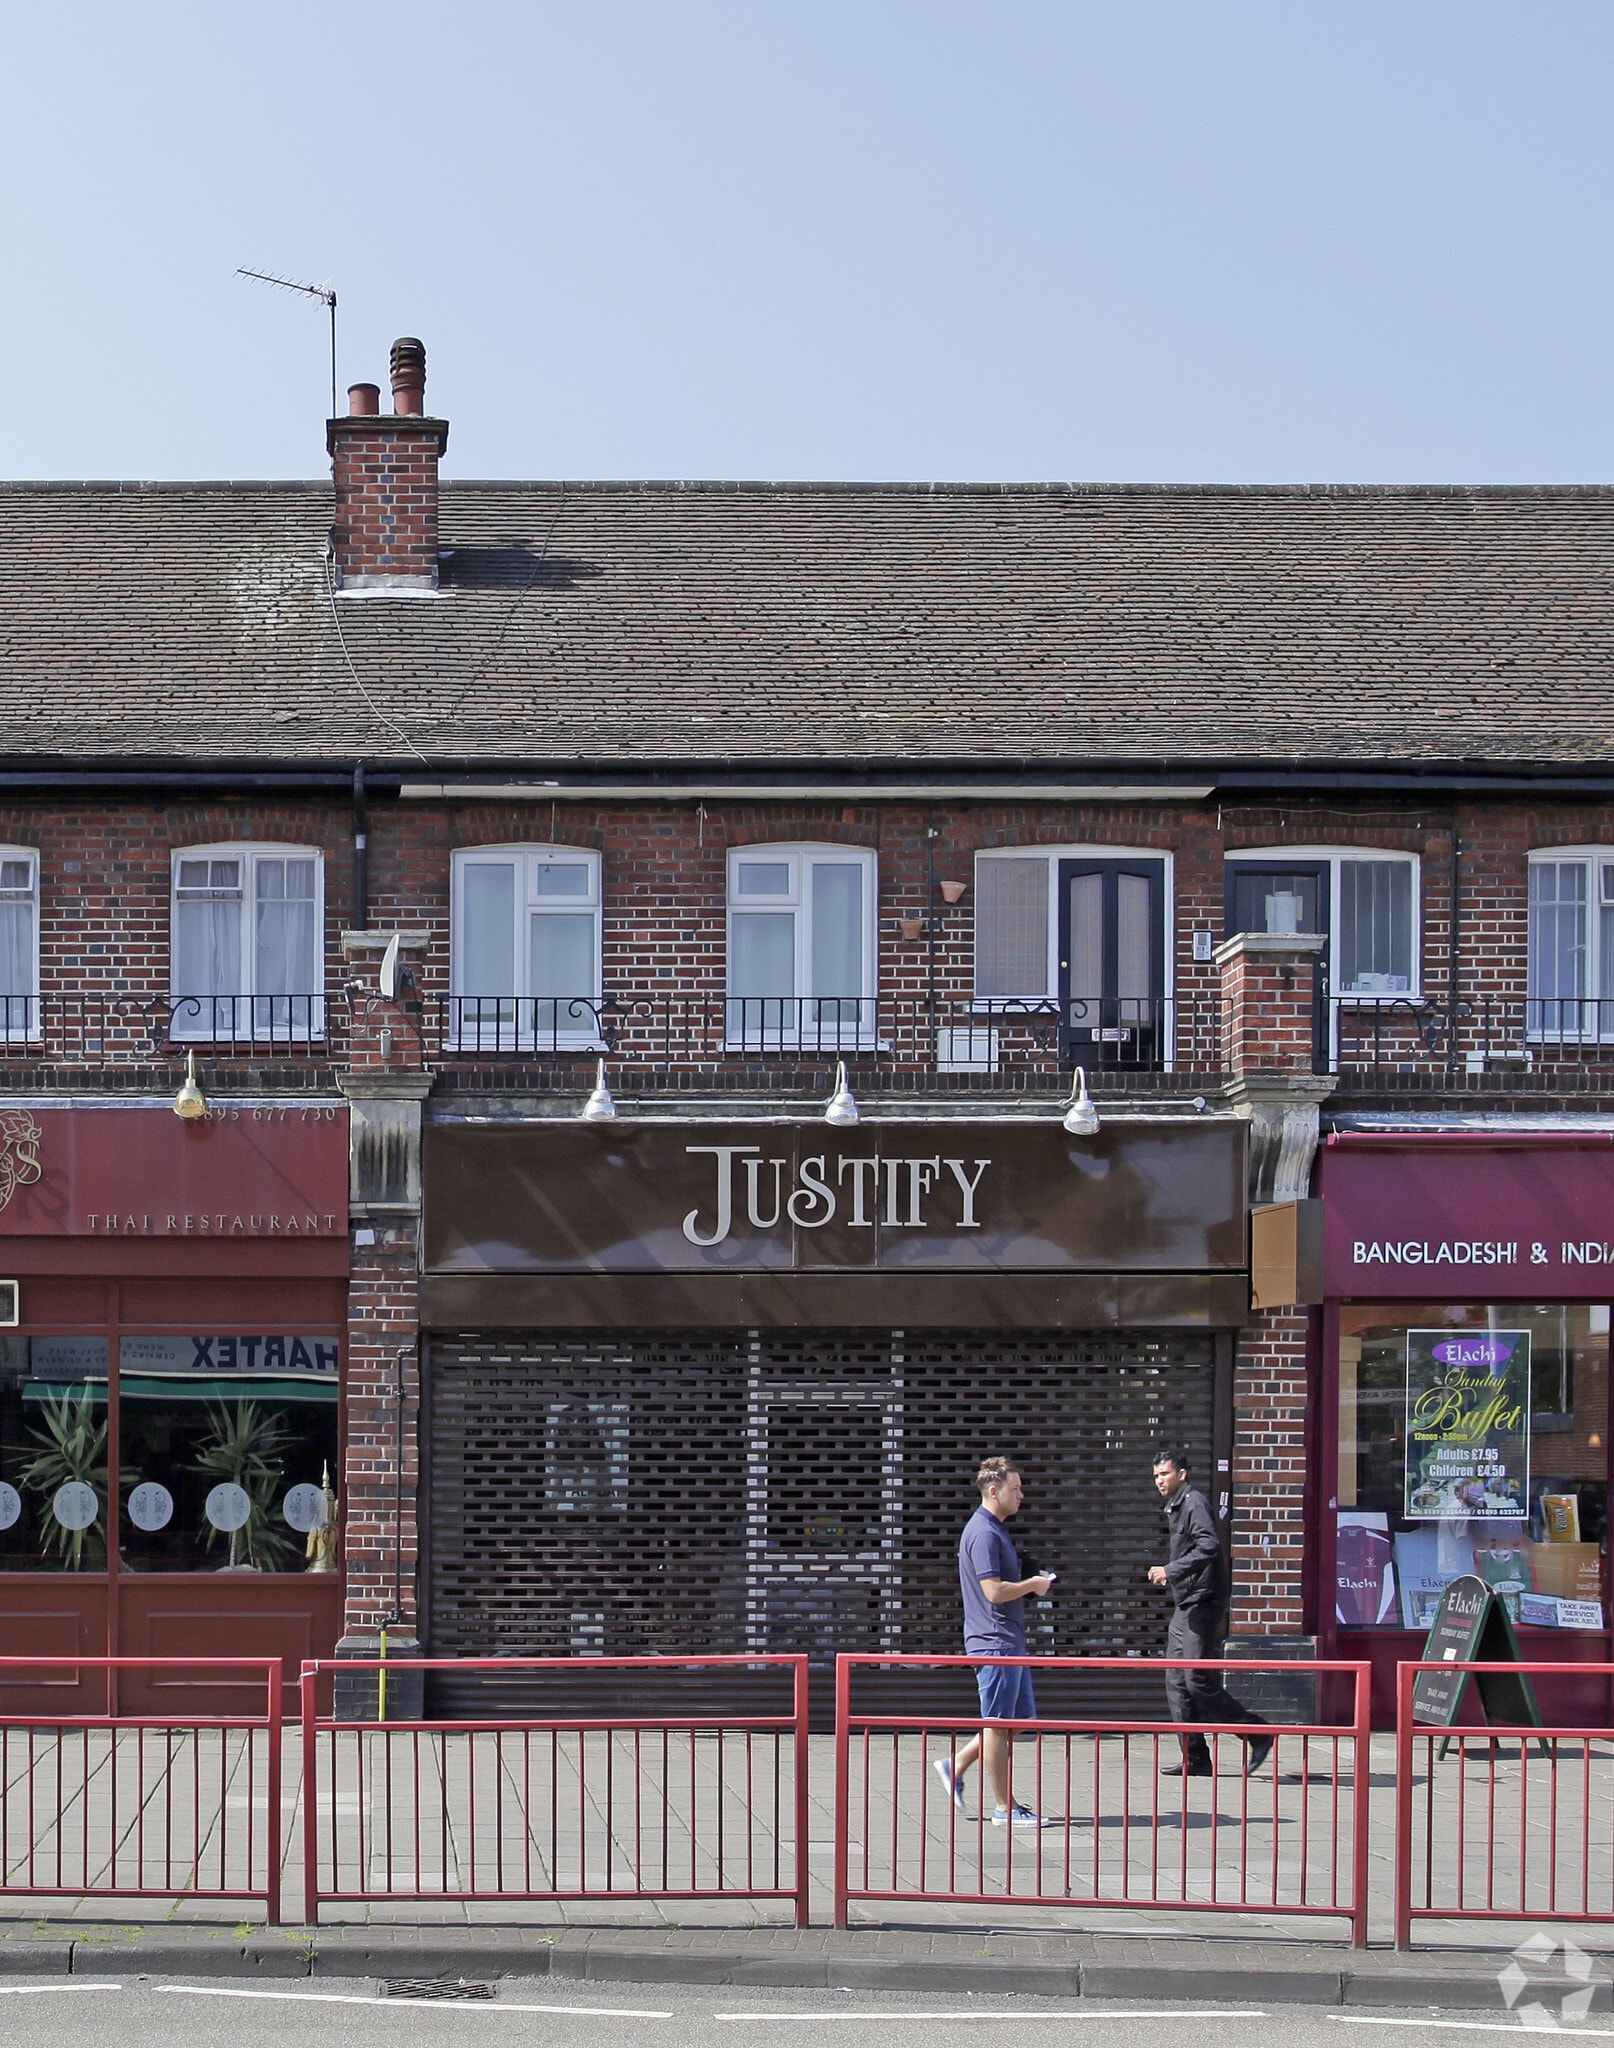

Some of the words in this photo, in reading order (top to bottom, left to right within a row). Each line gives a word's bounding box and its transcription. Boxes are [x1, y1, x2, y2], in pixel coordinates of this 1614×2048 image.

[179, 1106, 240, 1121] 895
[252, 1106, 288, 1121] 677
[300, 1106, 336, 1121] 730
[682, 1146, 992, 1247] JUSTIFY
[87, 1214, 150, 1229] THAI
[166, 1214, 337, 1229] RESTAURANT
[1353, 1242, 1518, 1264] BANGLADESHI
[1529, 1242, 1549, 1264] &
[1446, 1344, 1497, 1362] Elachi
[1444, 1368, 1507, 1396] Sunday
[1413, 1387, 1522, 1444] Buffet
[1437, 1448, 1470, 1460] Adults
[1471, 1448, 1499, 1460] £7.95
[1429, 1464, 1473, 1477] Children
[1477, 1464, 1506, 1477] £4.50
[1336, 1577, 1378, 1589] Elachi
[1446, 1591, 1483, 1616] Elachi
[1559, 1602, 1577, 1610] TAKE
[1561, 1617, 1600, 1625] AVAILABLE
[1564, 1610, 1595, 1618] SERVICE
